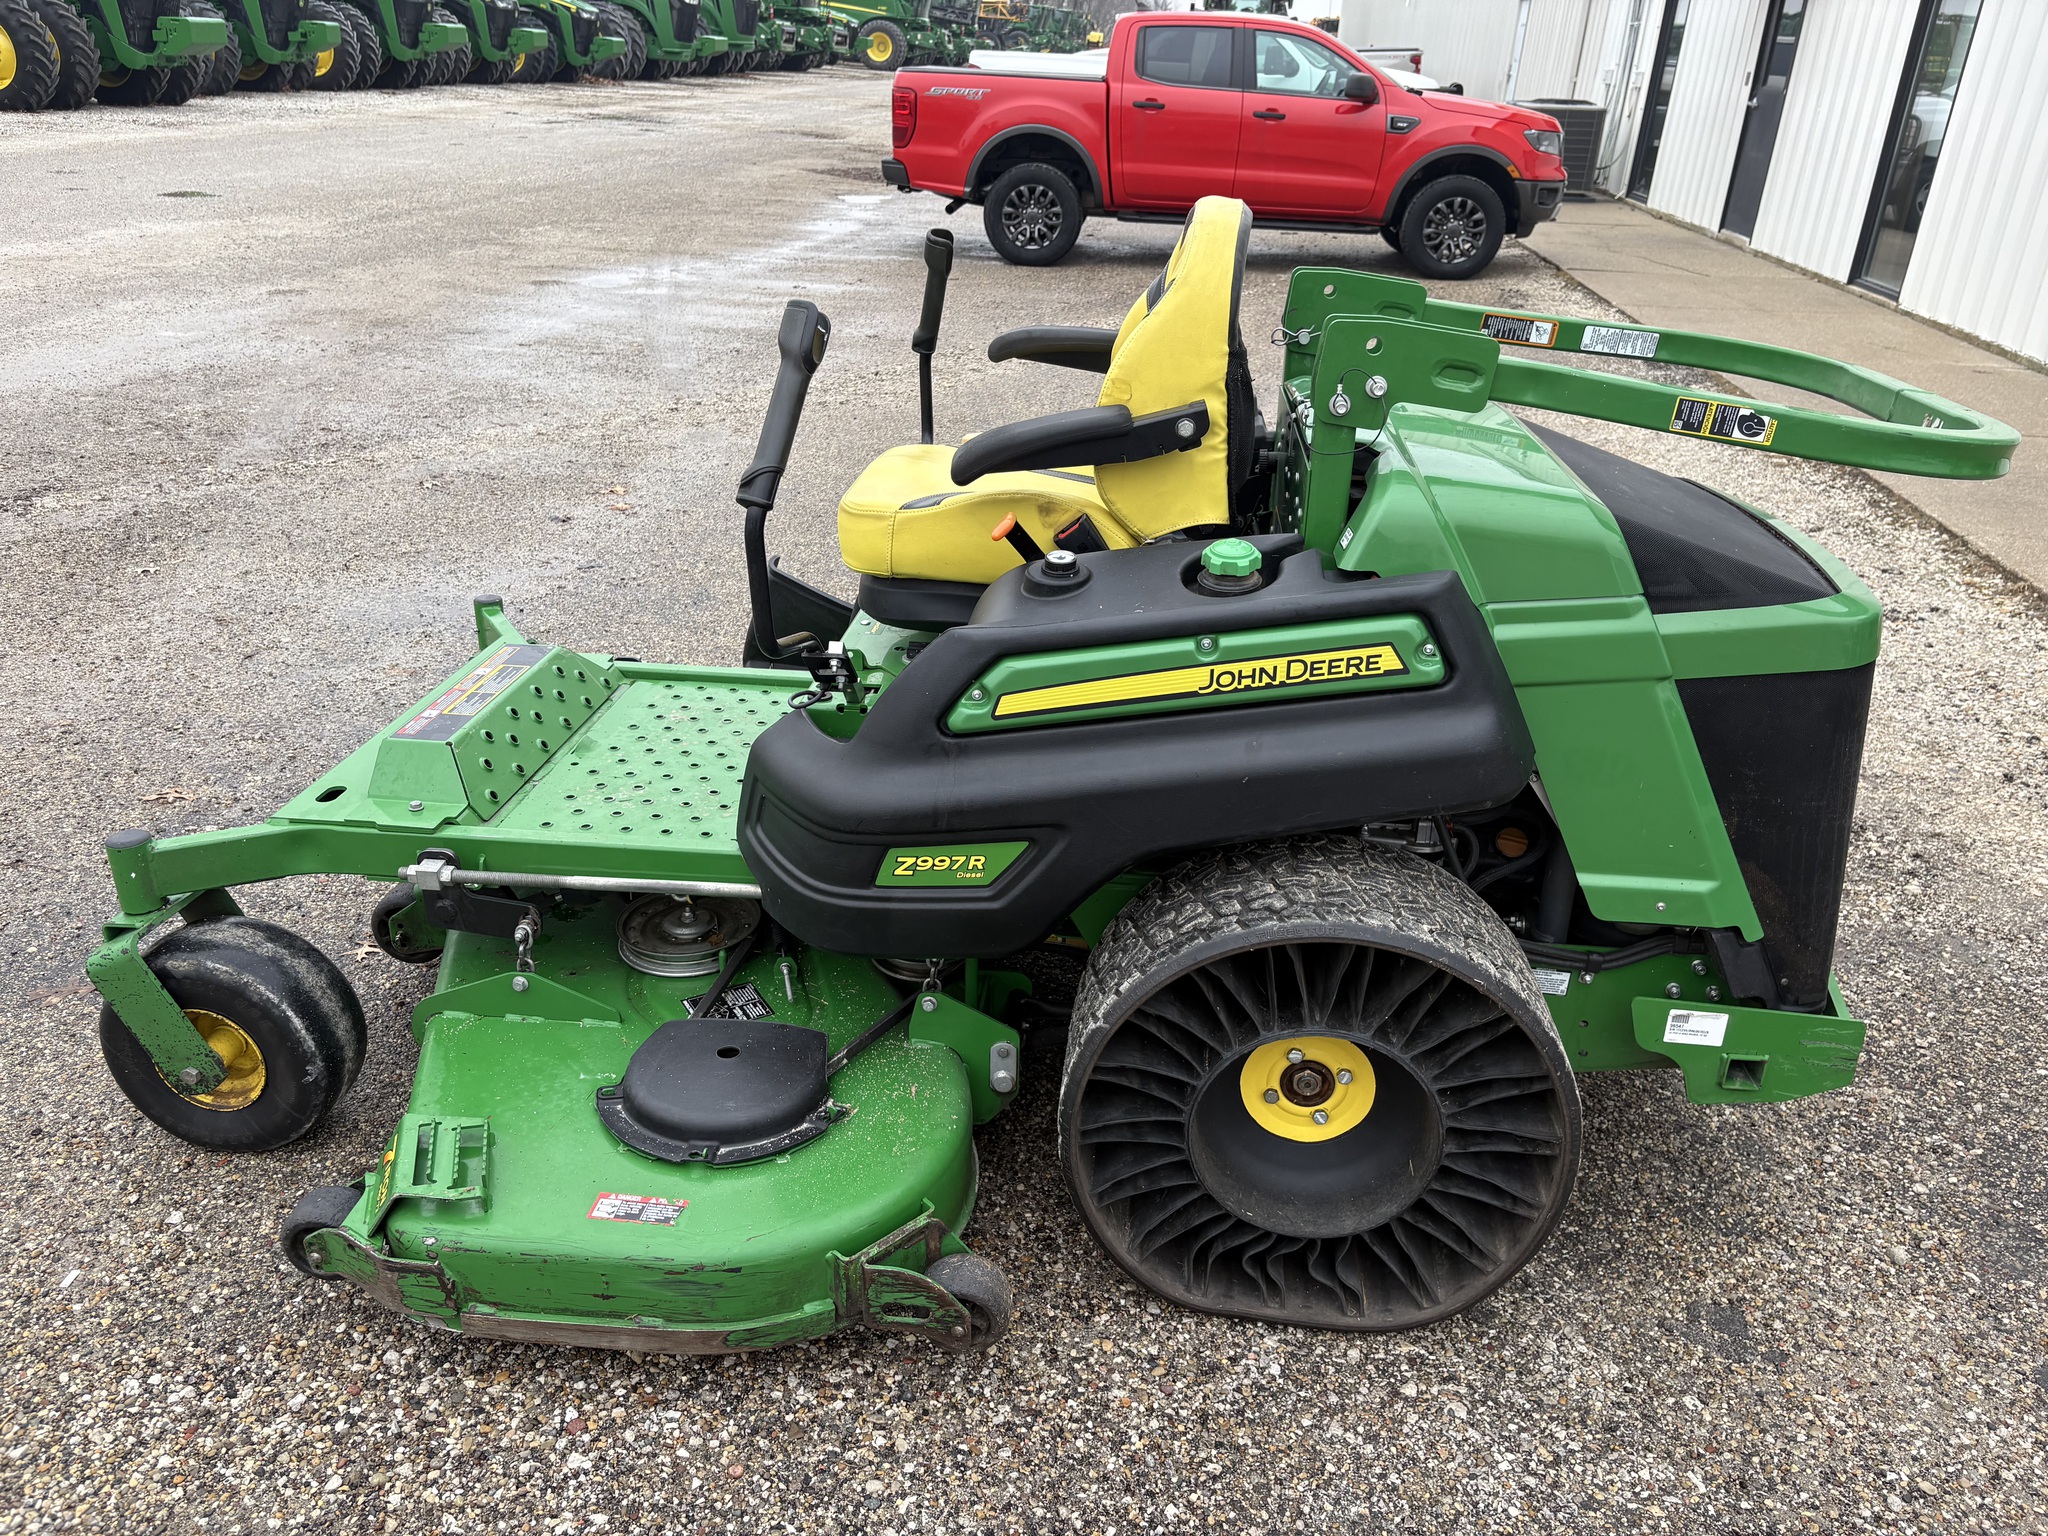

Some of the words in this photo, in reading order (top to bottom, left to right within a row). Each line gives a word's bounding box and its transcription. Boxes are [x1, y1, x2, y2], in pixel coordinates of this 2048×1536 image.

[924, 86, 991, 97] SPORT
[1197, 666, 1279, 694] JOHN
[1283, 653, 1384, 683] DEERE
[956, 871, 984, 879] Diesel
[1305, 924, 1344, 936] TURF
[617, 1194, 643, 1202] DANGER
